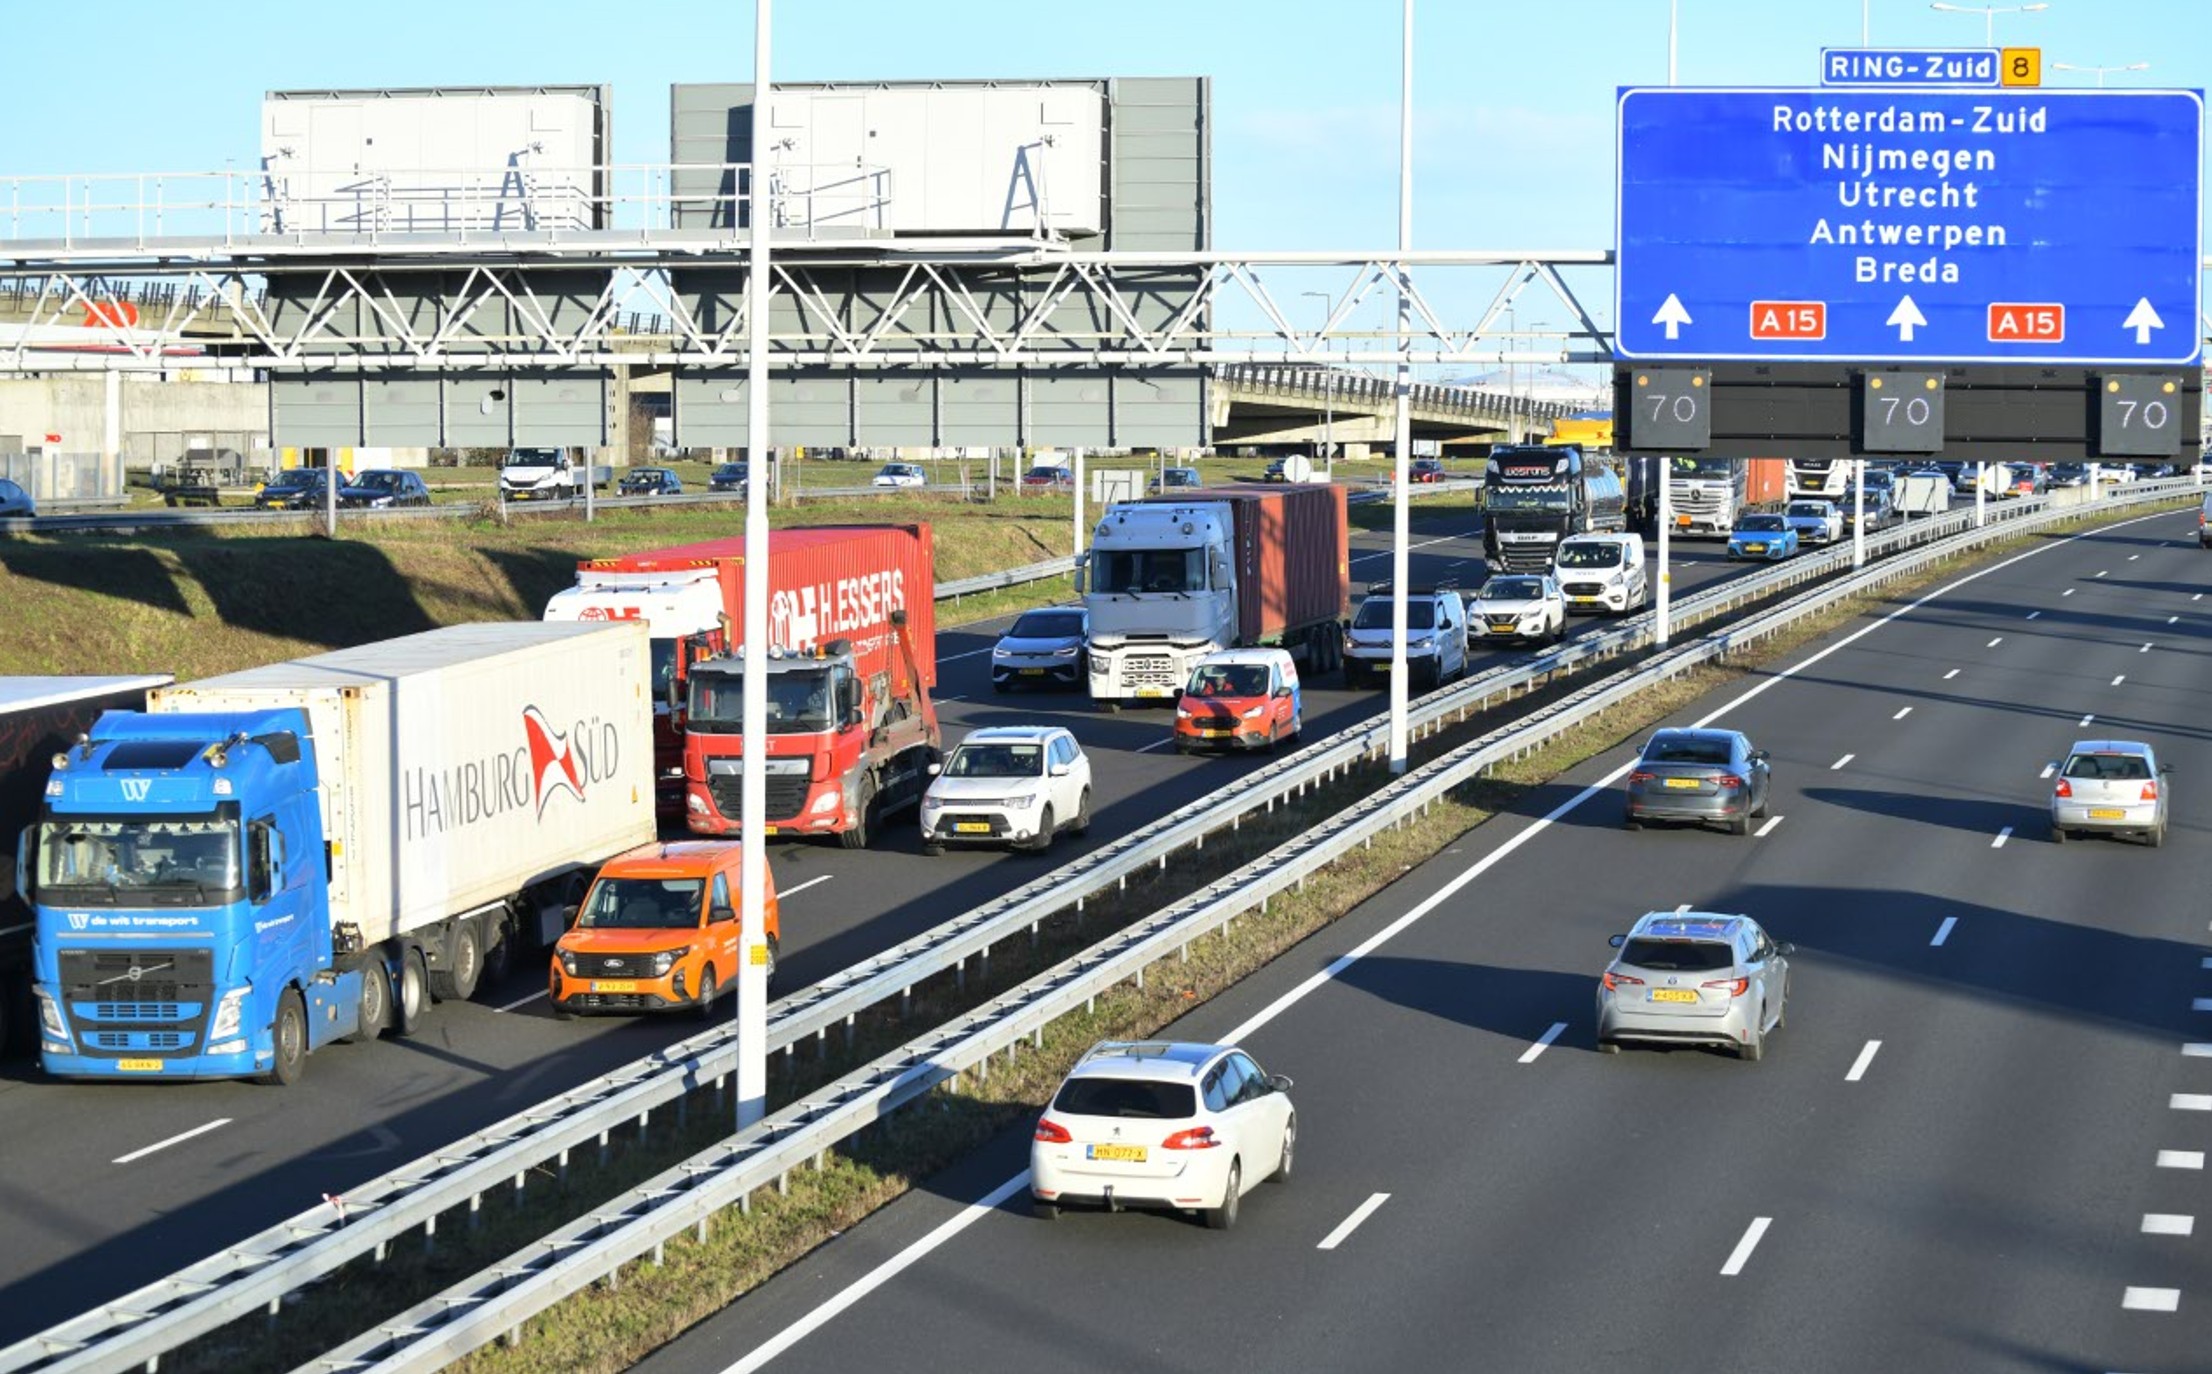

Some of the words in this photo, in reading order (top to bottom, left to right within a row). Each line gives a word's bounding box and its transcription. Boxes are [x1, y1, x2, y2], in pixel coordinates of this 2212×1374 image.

[1831, 57, 1990, 78] RING-Zuid
[2013, 58, 2029, 77] 8
[1773, 106, 2046, 133] Rotterdam-Zuid
[1823, 143, 1995, 178] Nijmegen
[1839, 181, 1978, 209] Utrecht
[1810, 218, 2006, 251] Antwerpen
[1856, 257, 1959, 283] Breda
[1647, 395, 1696, 422] 70
[1880, 397, 1930, 425] 70
[2117, 400, 2168, 429] 70
[405, 746, 530, 842] HAMBURG
[573, 716, 619, 790] SÜD
[132, 916, 199, 927] transport
